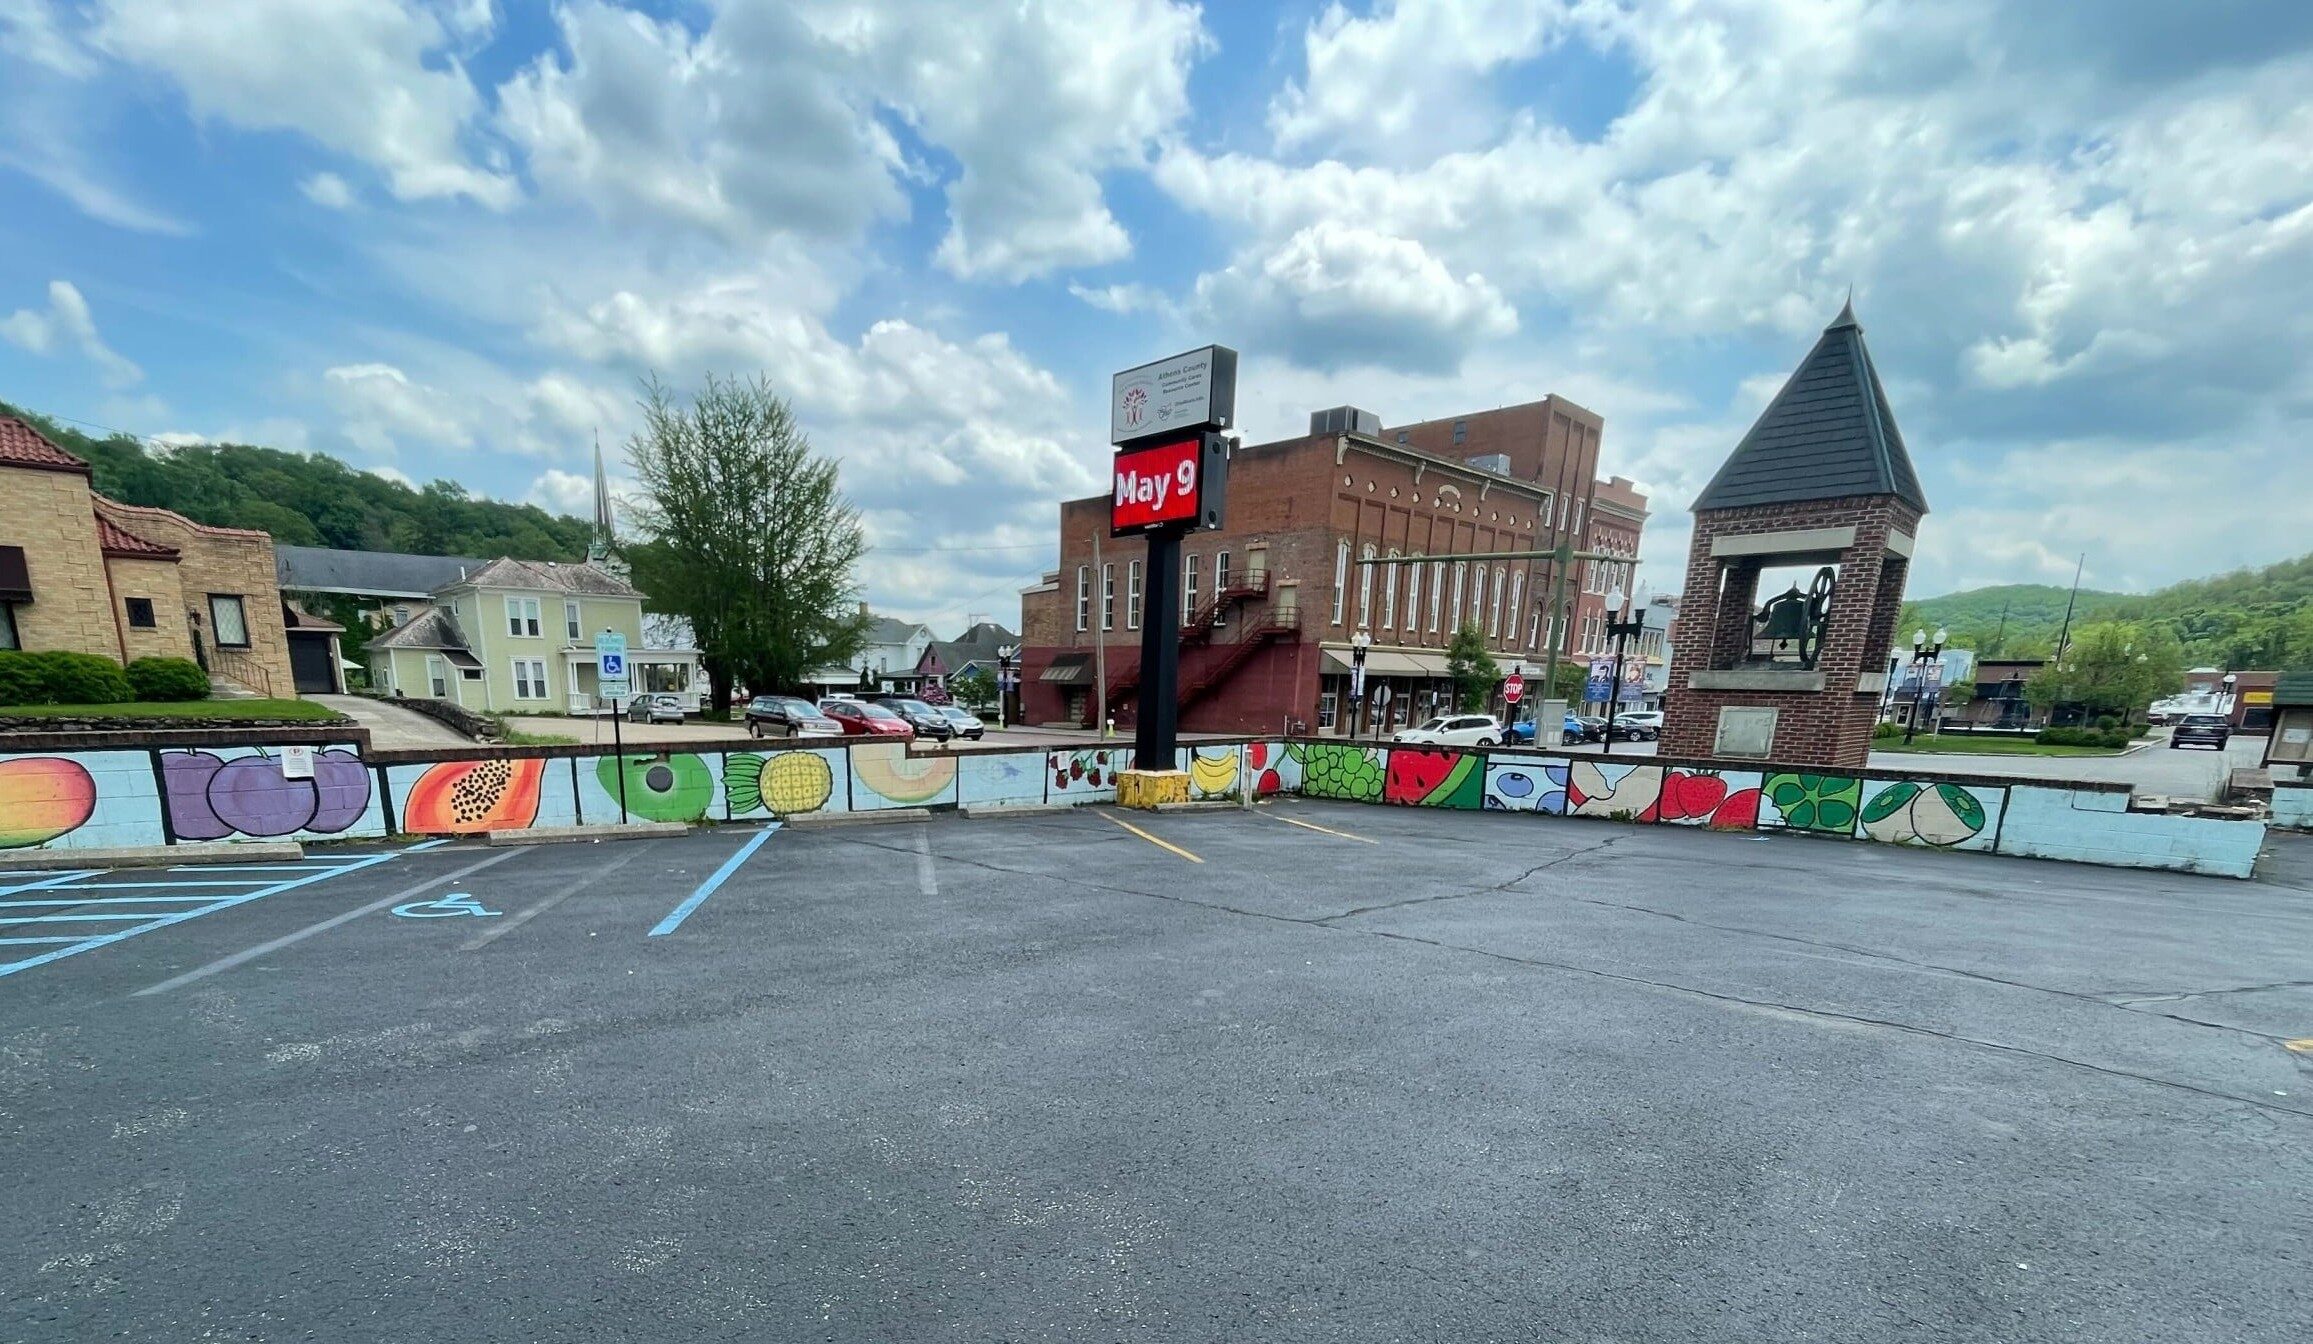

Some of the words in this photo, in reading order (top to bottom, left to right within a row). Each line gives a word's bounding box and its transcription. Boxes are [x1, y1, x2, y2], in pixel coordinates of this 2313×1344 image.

[1158, 369, 1181, 381] Athens
[1183, 362, 1207, 374] County
[1184, 380, 1201, 389] Center
[1116, 470, 1172, 511] May
[1177, 459, 1195, 496] 9
[1505, 683, 1522, 694] STOP
